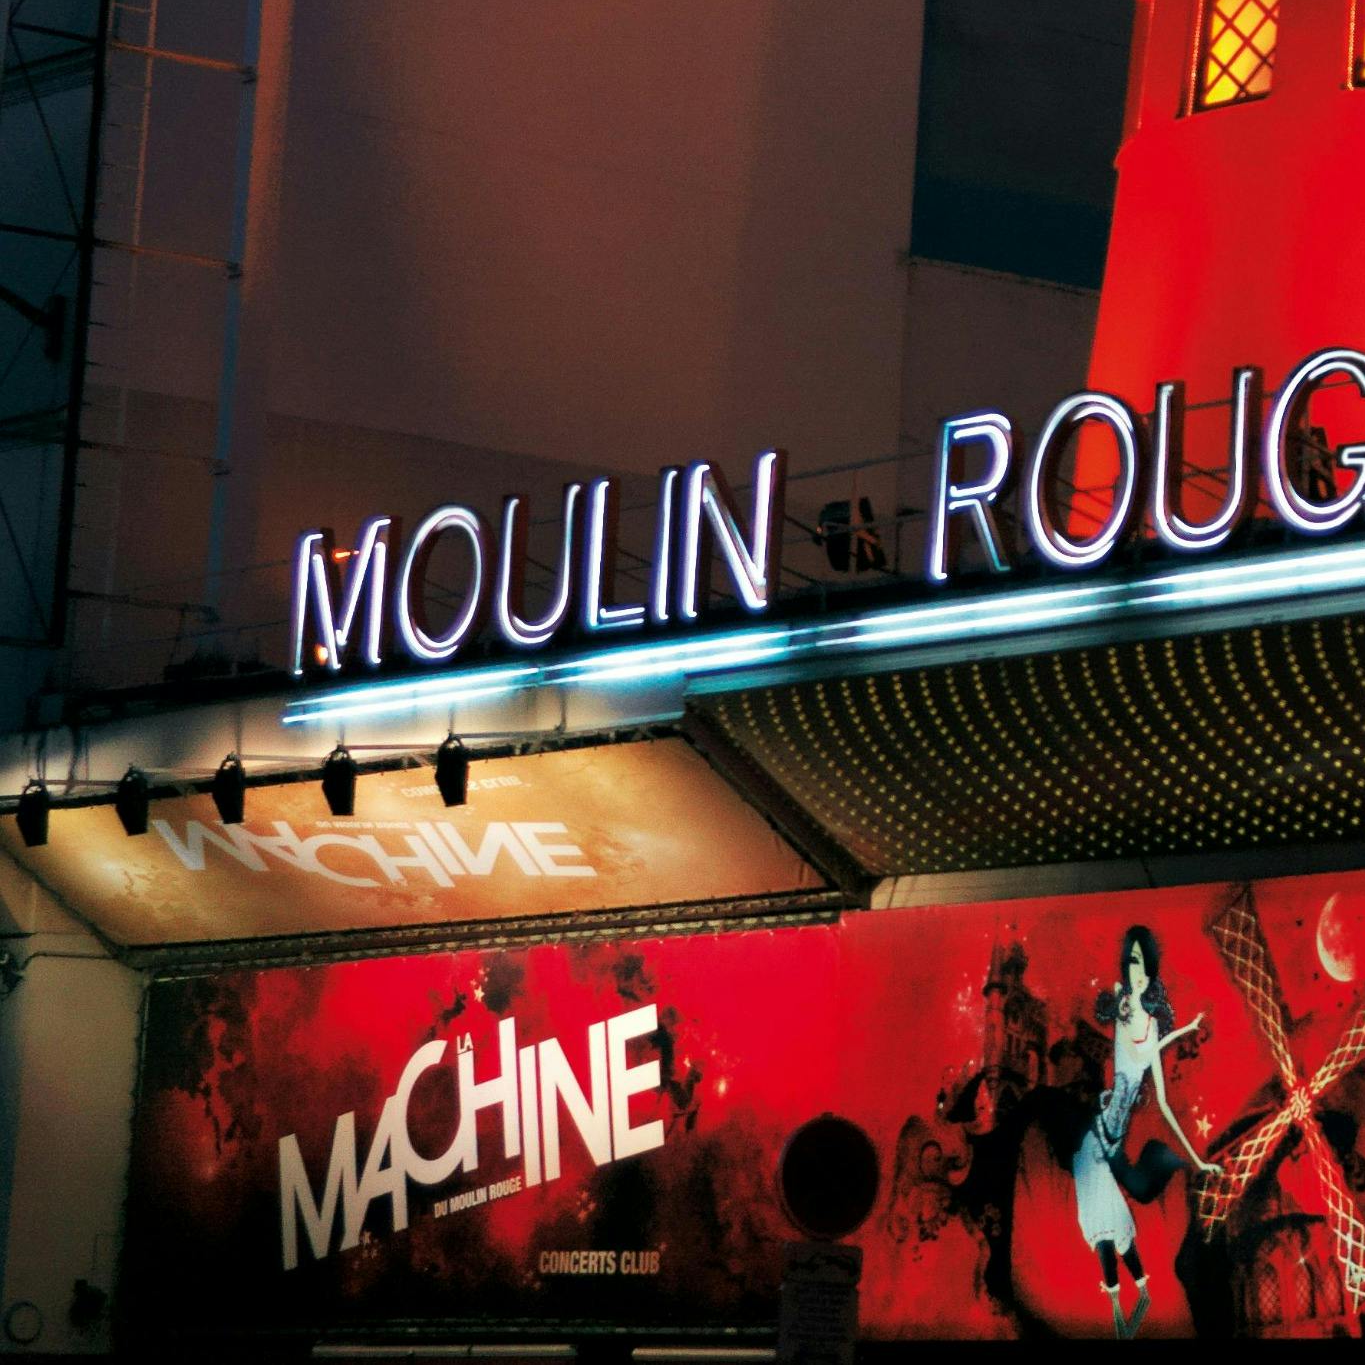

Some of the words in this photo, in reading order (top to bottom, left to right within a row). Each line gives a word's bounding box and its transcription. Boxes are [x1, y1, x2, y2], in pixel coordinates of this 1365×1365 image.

[294, 448, 784, 677] MOULIN
[457, 1032, 474, 1054] LA
[278, 1003, 665, 1272] MACHINE
[434, 1202, 449, 1219] DU
[450, 1187, 488, 1213] MOULIN
[489, 1176, 522, 1202] ROUGE
[539, 1250, 617, 1275] CONCERTS
[620, 1250, 661, 1275] CLUB
